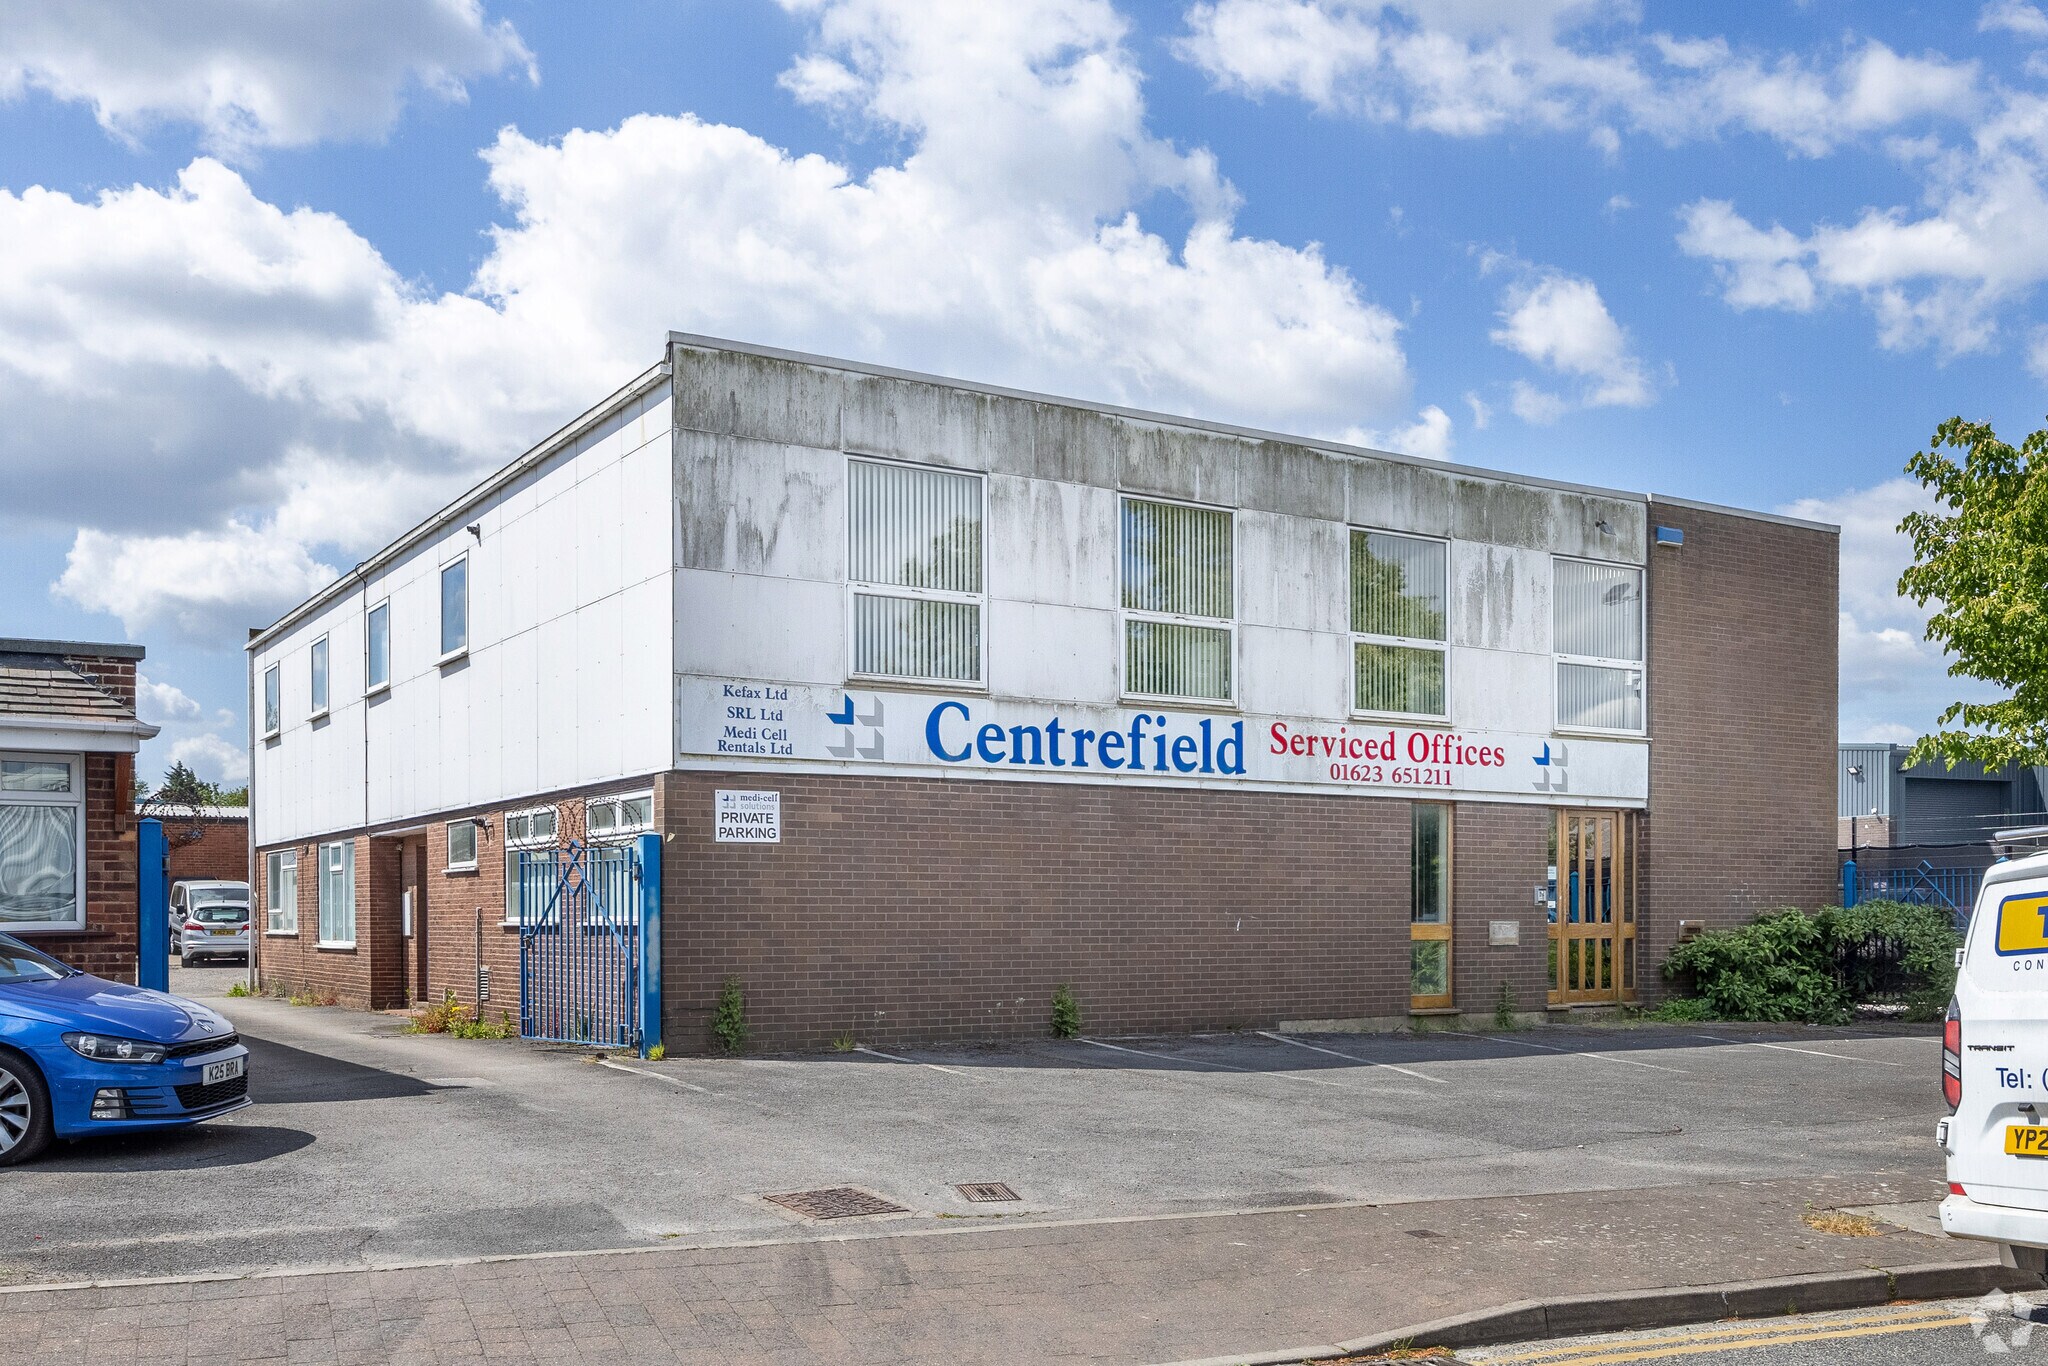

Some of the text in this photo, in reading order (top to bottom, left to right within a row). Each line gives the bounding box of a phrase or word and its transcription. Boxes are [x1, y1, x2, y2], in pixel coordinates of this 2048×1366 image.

[723, 684, 788, 700] Kefax Ltd
[727, 706, 783, 721] SRL Ltd
[723, 725, 787, 741] Medi Cell
[925, 701, 1247, 775] Centrefield
[717, 739, 793, 755] Rentals Ltd
[1270, 722, 1505, 767] Serviced Offices
[1329, 763, 1453, 786] 01623 651211
[740, 793, 778, 803] medi-cell
[740, 802, 775, 810] solutions
[721, 811, 774, 824] PRIVATE
[718, 826, 777, 839] PARKING
[208, 1060, 239, 1082] K25 BRA
[1995, 1067, 2032, 1089] Tel:
[2014, 1128, 2048, 1151] YP2
